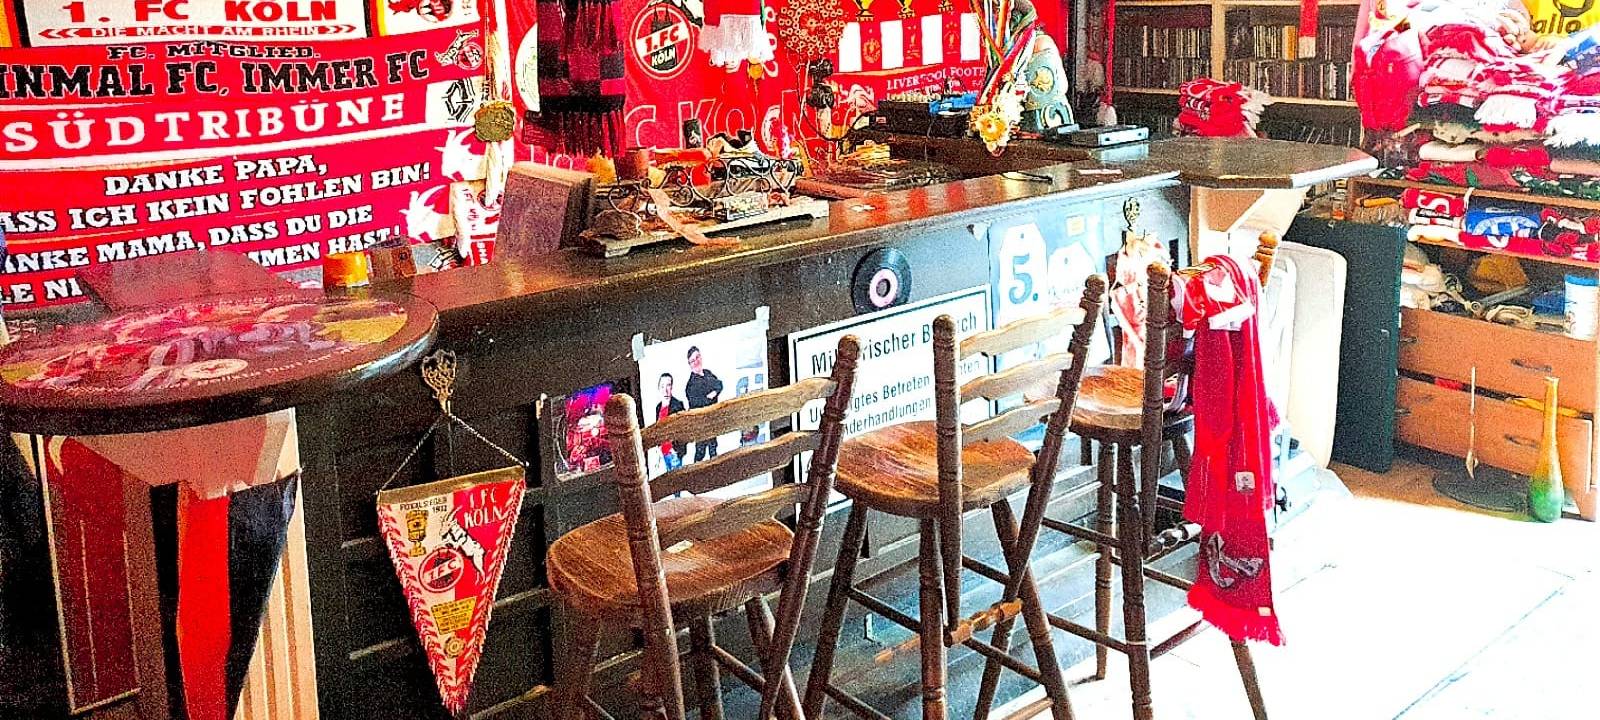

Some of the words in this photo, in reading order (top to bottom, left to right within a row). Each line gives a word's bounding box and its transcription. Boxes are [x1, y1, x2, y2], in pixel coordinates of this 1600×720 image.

[135, 0, 189, 22] FC
[92, 27, 127, 37] DIE
[138, 26, 211, 37] MACHT
[221, 26, 253, 36] AM
[263, 26, 318, 36] RHEIN
[646, 26, 679, 53] 1.FC
[107, 46, 155, 59] FC.
[167, 42, 320, 59] MITGLIED.
[165, 61, 229, 97] FC,
[241, 57, 377, 94] IMMER
[385, 50, 429, 85] FC
[2, 93, 405, 152] SÜDTRIBÜNE
[104, 165, 225, 197] DANKE
[236, 154, 328, 181] PAPA,
[68, 204, 138, 230] ICH
[145, 192, 231, 222] KEIN
[240, 174, 363, 209] FOHLEN
[371, 162, 430, 189] BIN!
[96, 230, 206, 264] MAMA,
[208, 220, 279, 246] DASS
[285, 214, 321, 236] DU
[328, 204, 373, 229] DIE
[883, 375, 930, 400] Betreten
